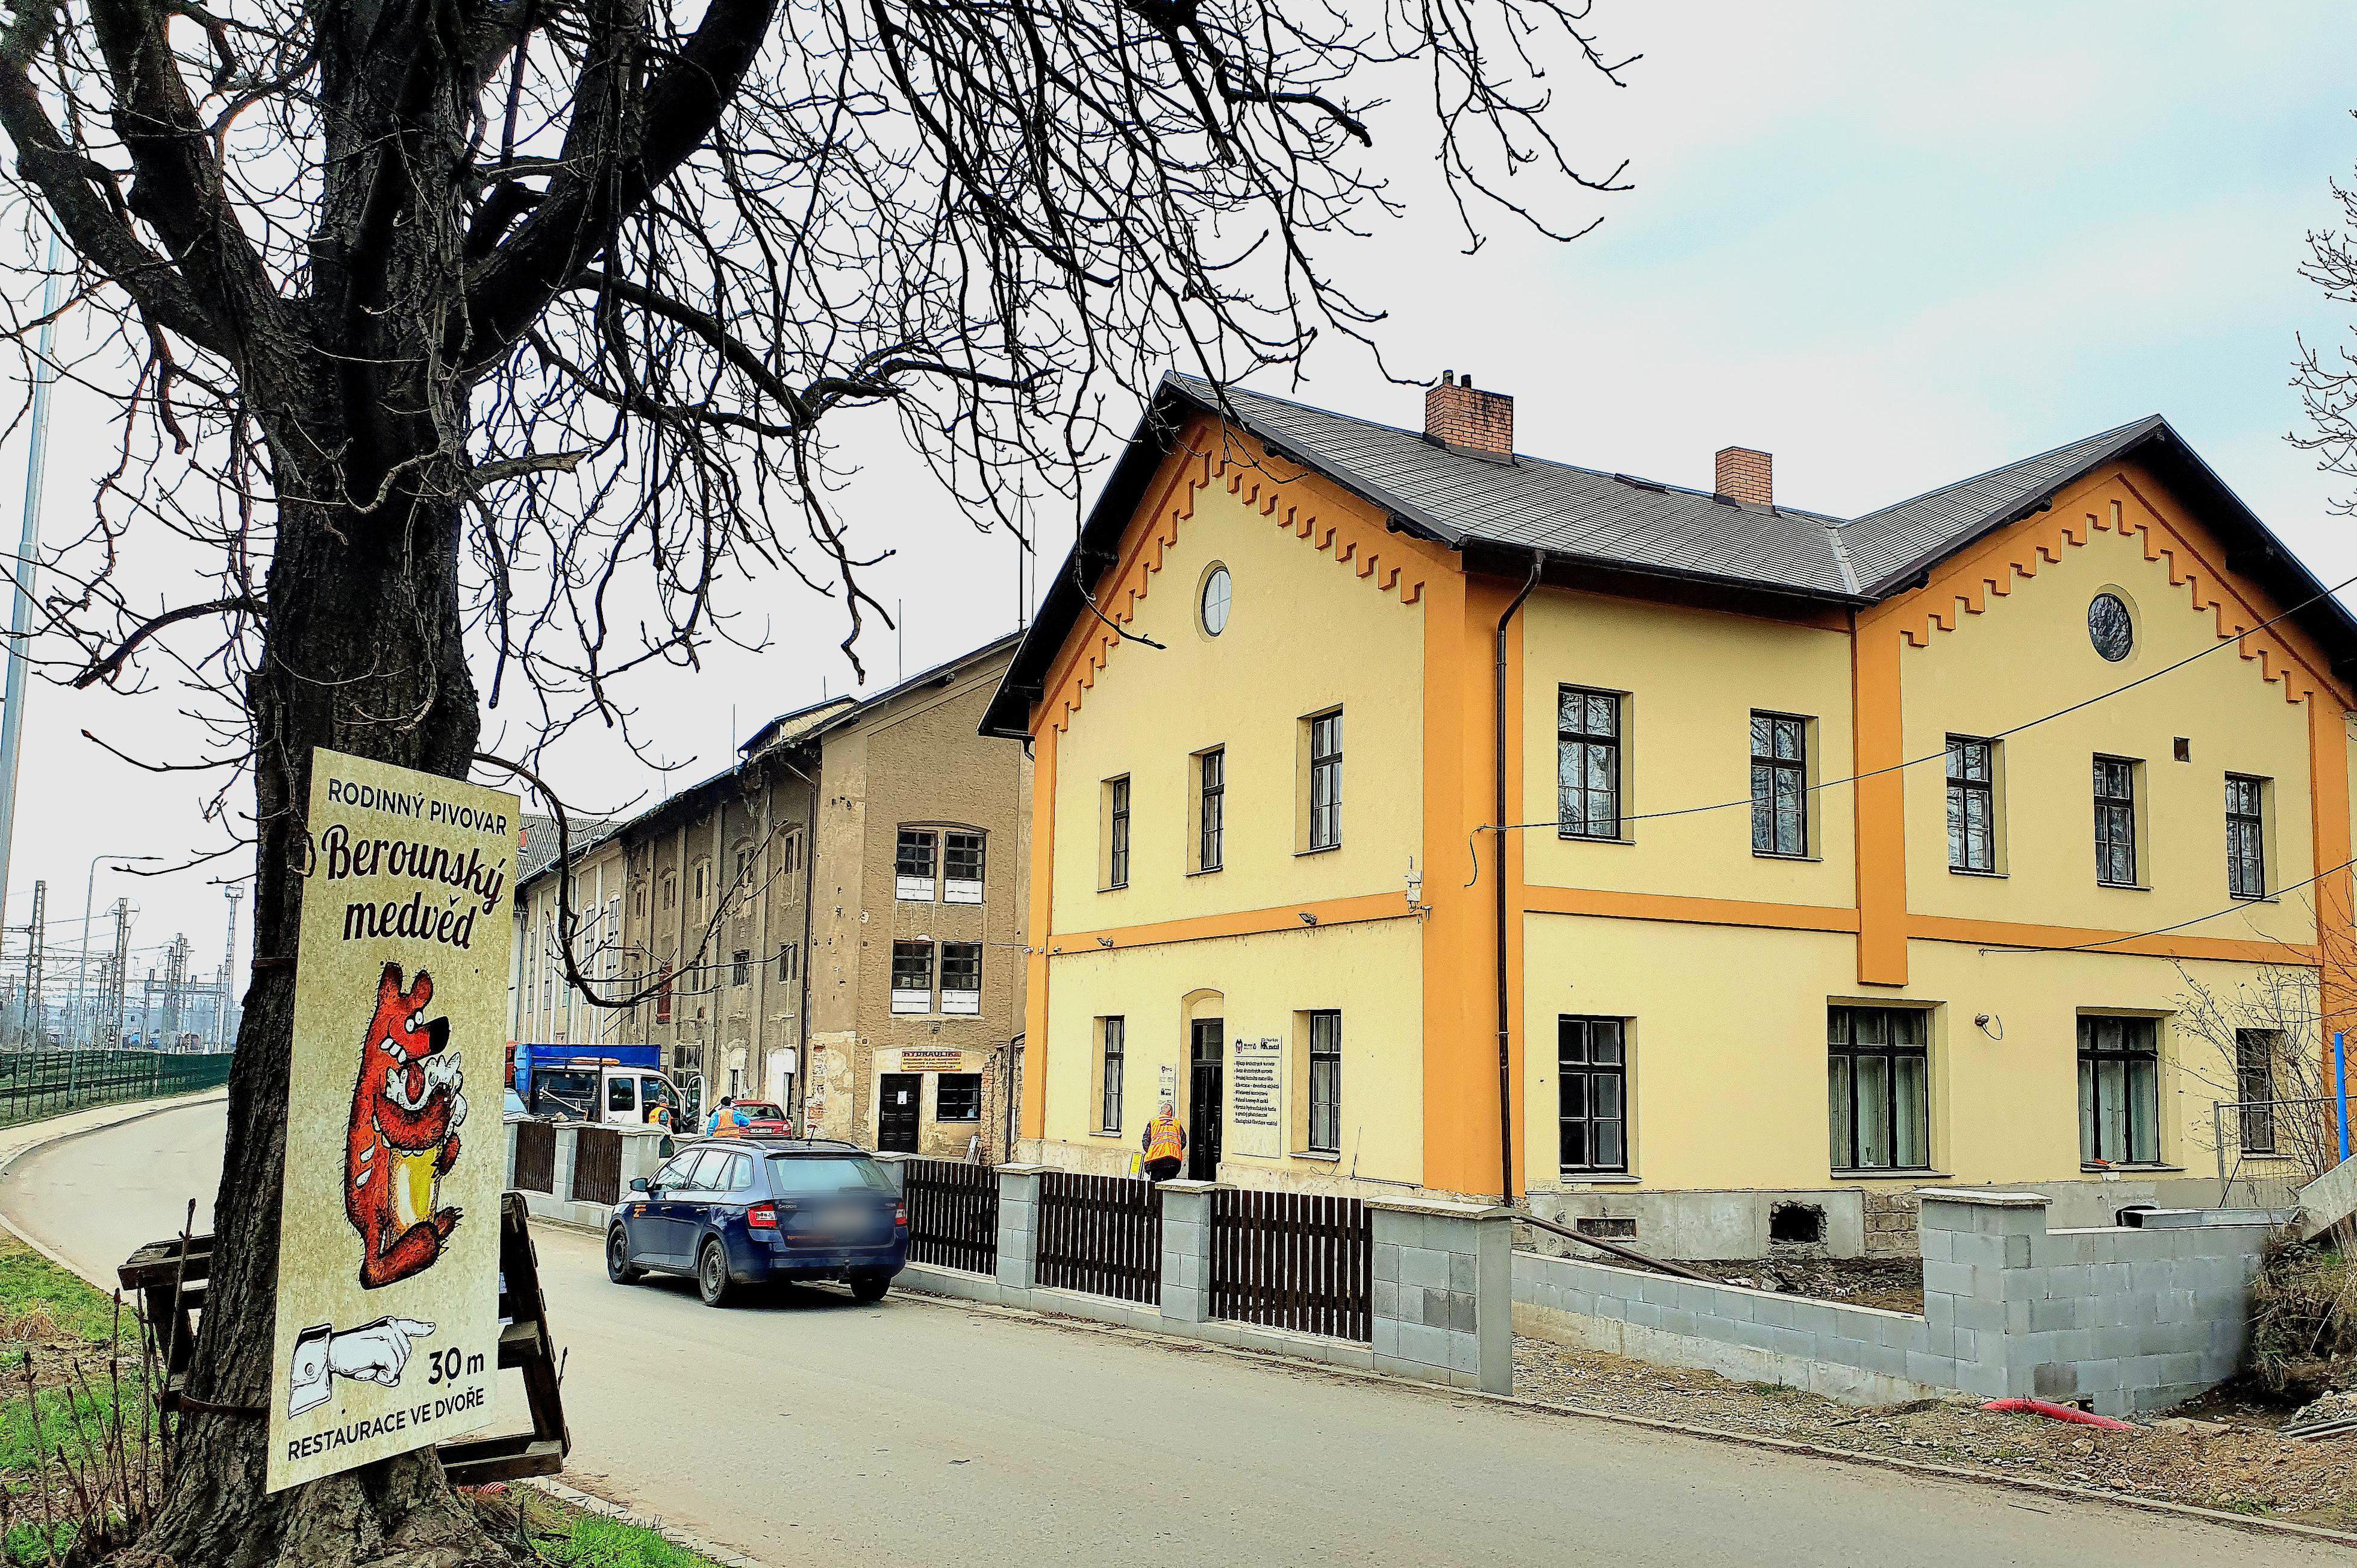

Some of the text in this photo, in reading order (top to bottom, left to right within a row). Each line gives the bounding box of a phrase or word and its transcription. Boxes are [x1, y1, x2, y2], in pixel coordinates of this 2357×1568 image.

[328, 778, 507, 836] RODINNÝ PIVOVAR
[322, 824, 507, 915] Berounský
[343, 891, 478, 950] medvěd
[428, 1347, 484, 1385] 30 m
[287, 1386, 484, 1461] RESTAURACE VE DVOŘE
